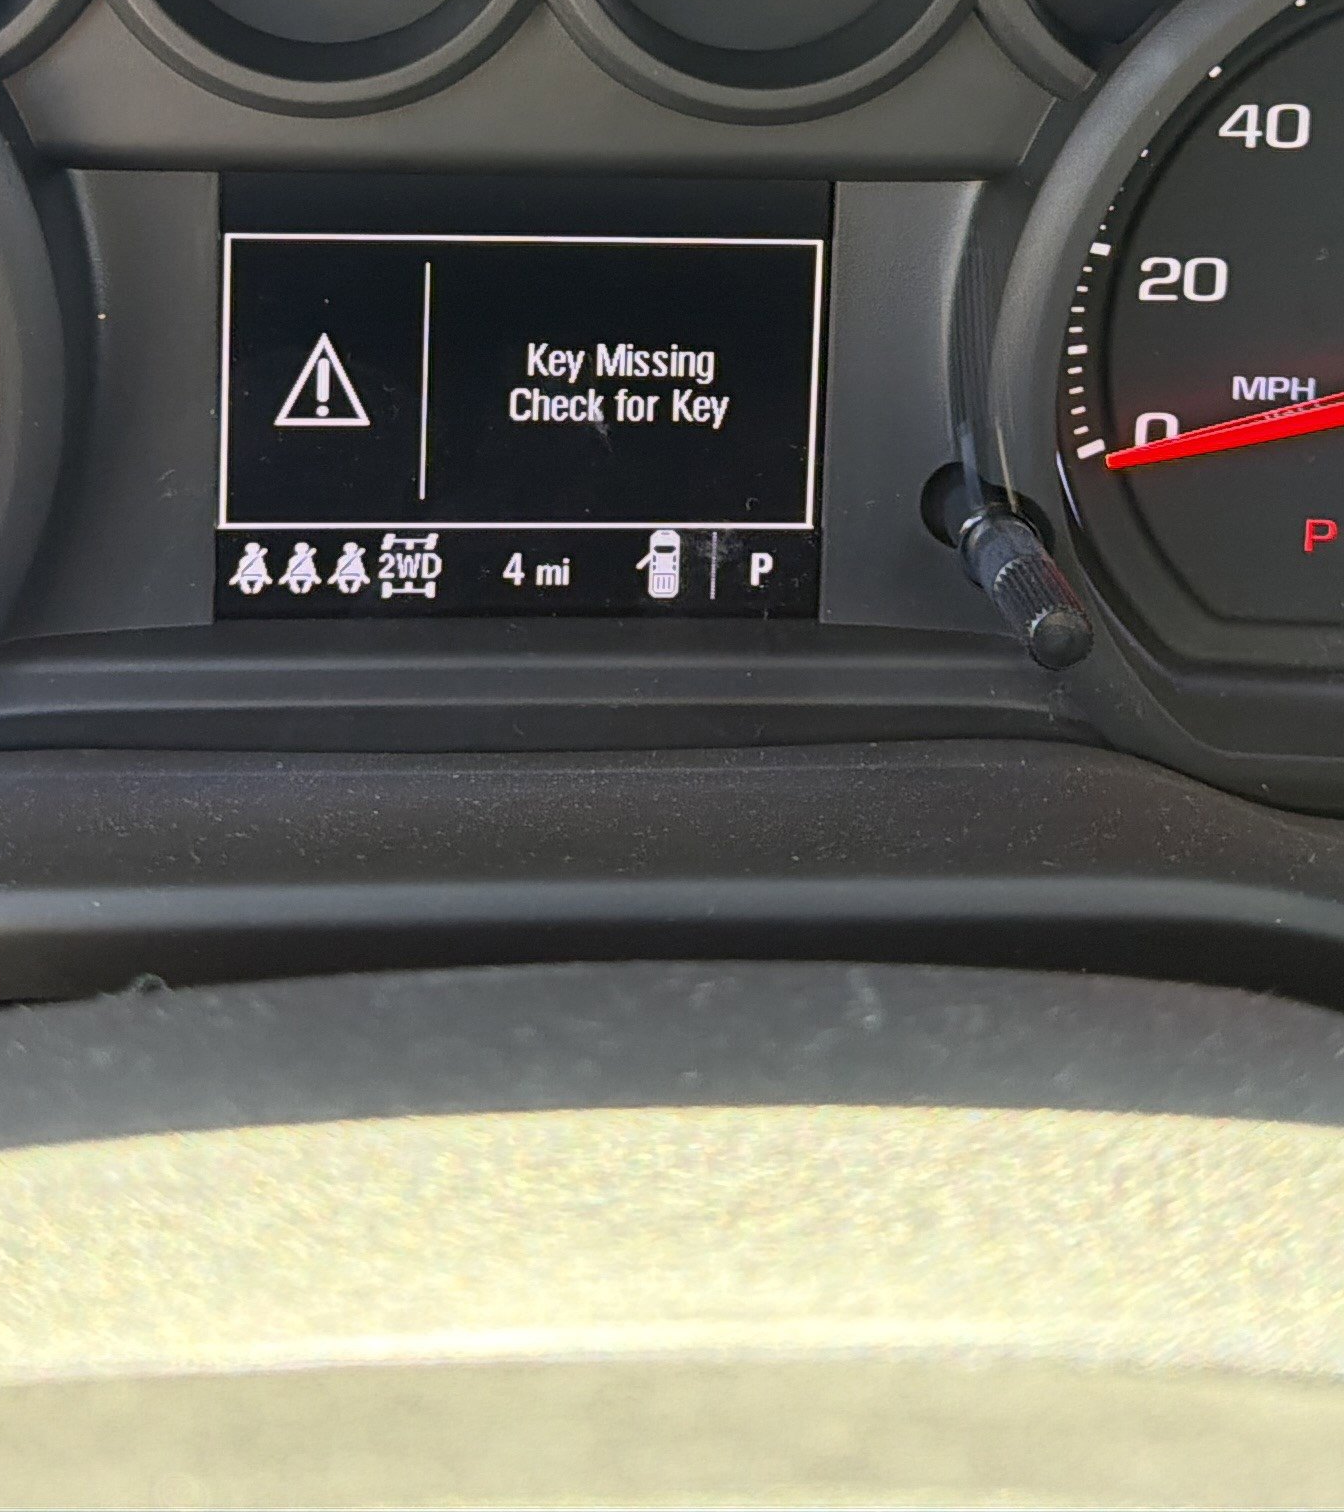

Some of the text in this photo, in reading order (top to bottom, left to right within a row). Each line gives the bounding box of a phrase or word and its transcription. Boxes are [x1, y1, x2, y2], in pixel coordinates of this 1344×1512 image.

[1218, 103, 1311, 149] 40
[1138, 256, 1228, 302] 20
[527, 342, 715, 384] Key Missing
[1232, 375, 1317, 402] MPH
[508, 387, 730, 430] Check for Key
[1303, 518, 1338, 553] P
[378, 552, 443, 579] 2WD
[502, 552, 571, 586] 4 mi
[750, 552, 774, 587] P
